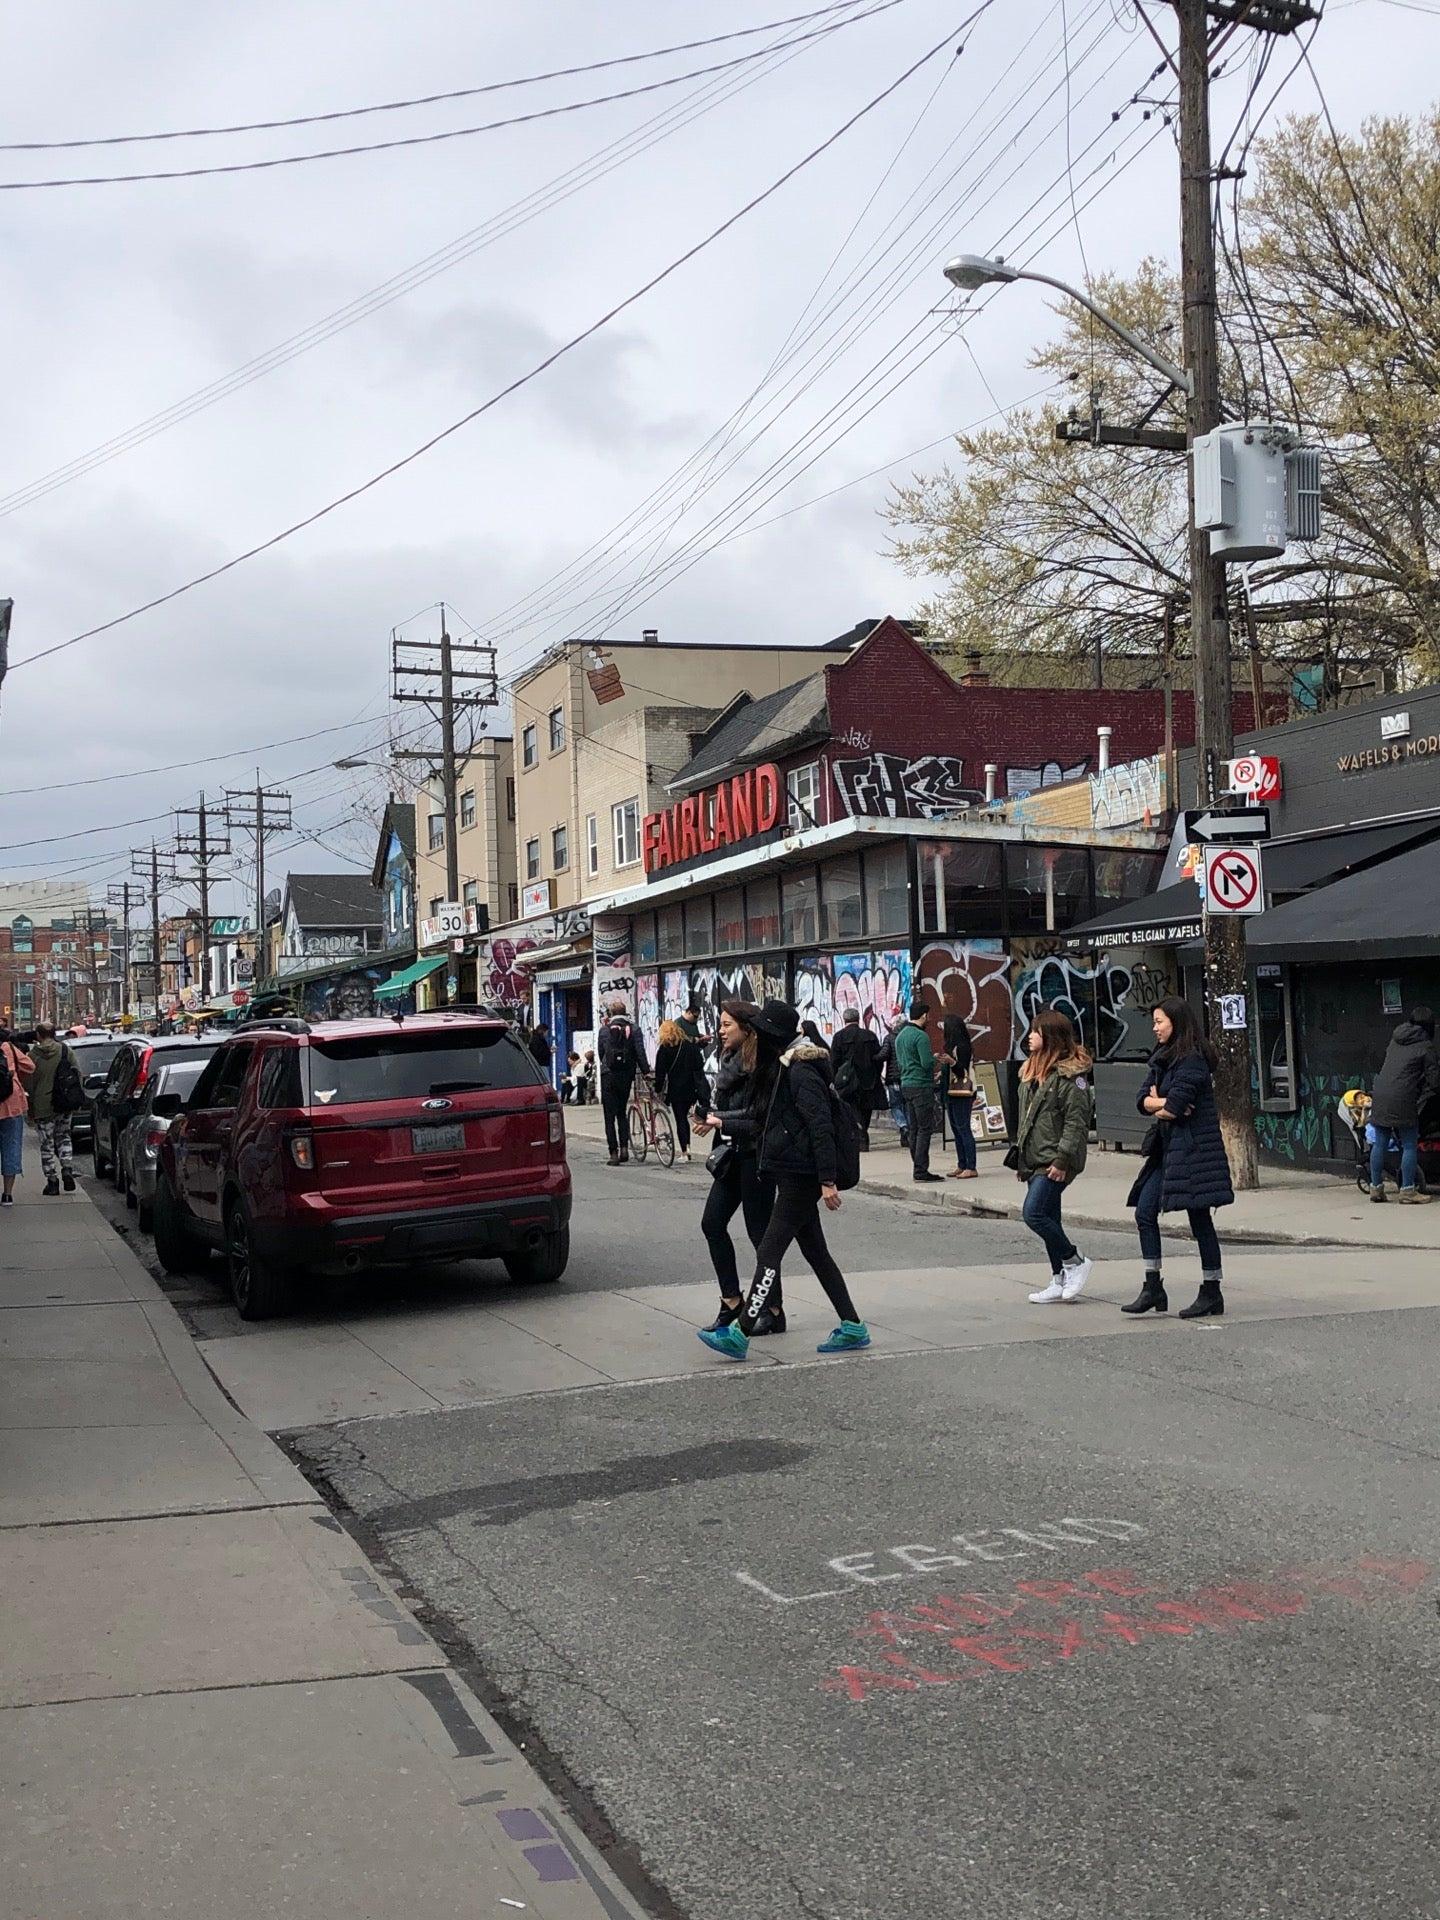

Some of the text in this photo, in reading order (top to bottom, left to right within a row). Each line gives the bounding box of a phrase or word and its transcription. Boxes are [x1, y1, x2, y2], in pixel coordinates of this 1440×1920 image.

[1337, 747, 1389, 772] WAFELS
[1391, 744, 1401, 761] &
[1406, 734, 1440, 757] MOR
[642, 763, 781, 873] FAIRLAND
[441, 916, 462, 931] 30
[1094, 931, 1130, 947] AUTENTIC
[1132, 929, 1166, 943] BELGIAN
[1168, 924, 1201, 940] WAFELS
[748, 1268, 776, 1318] adidas
[735, 1516, 1146, 1606] LEGEND
